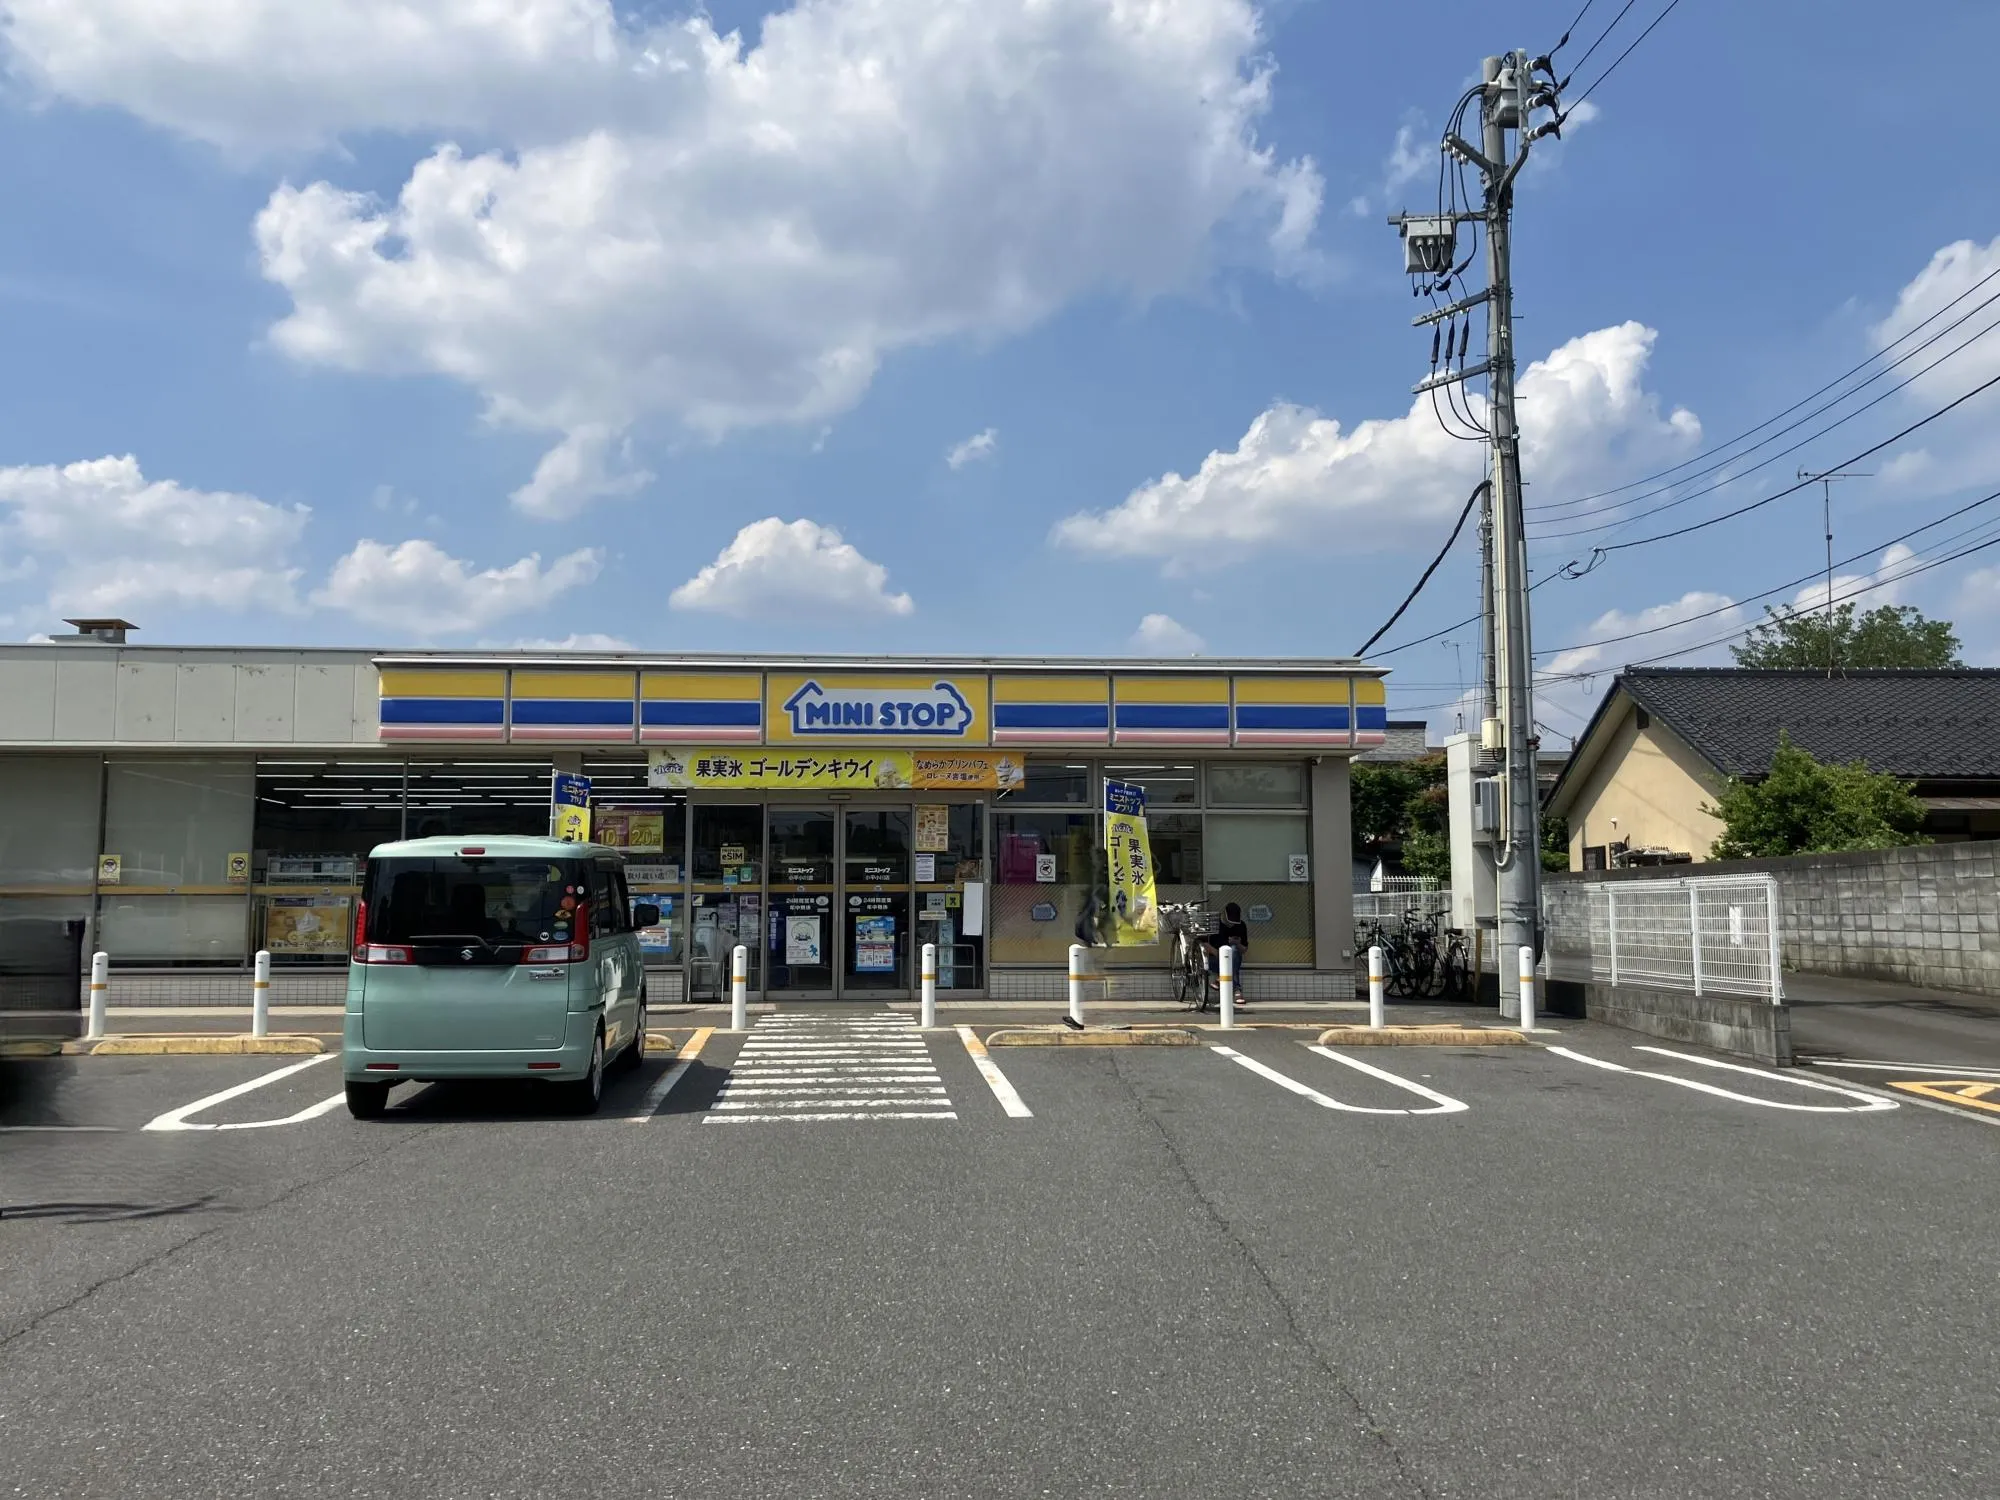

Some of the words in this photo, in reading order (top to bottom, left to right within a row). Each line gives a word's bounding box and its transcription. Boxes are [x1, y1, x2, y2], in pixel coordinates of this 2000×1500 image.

[806, 702, 873, 726] MINI
[879, 702, 955, 726] STOP
[696, 759, 743, 778] 果実氷
[749, 758, 874, 778] ゴールデンキウイ
[1128, 838, 1145, 885] 果実氷
